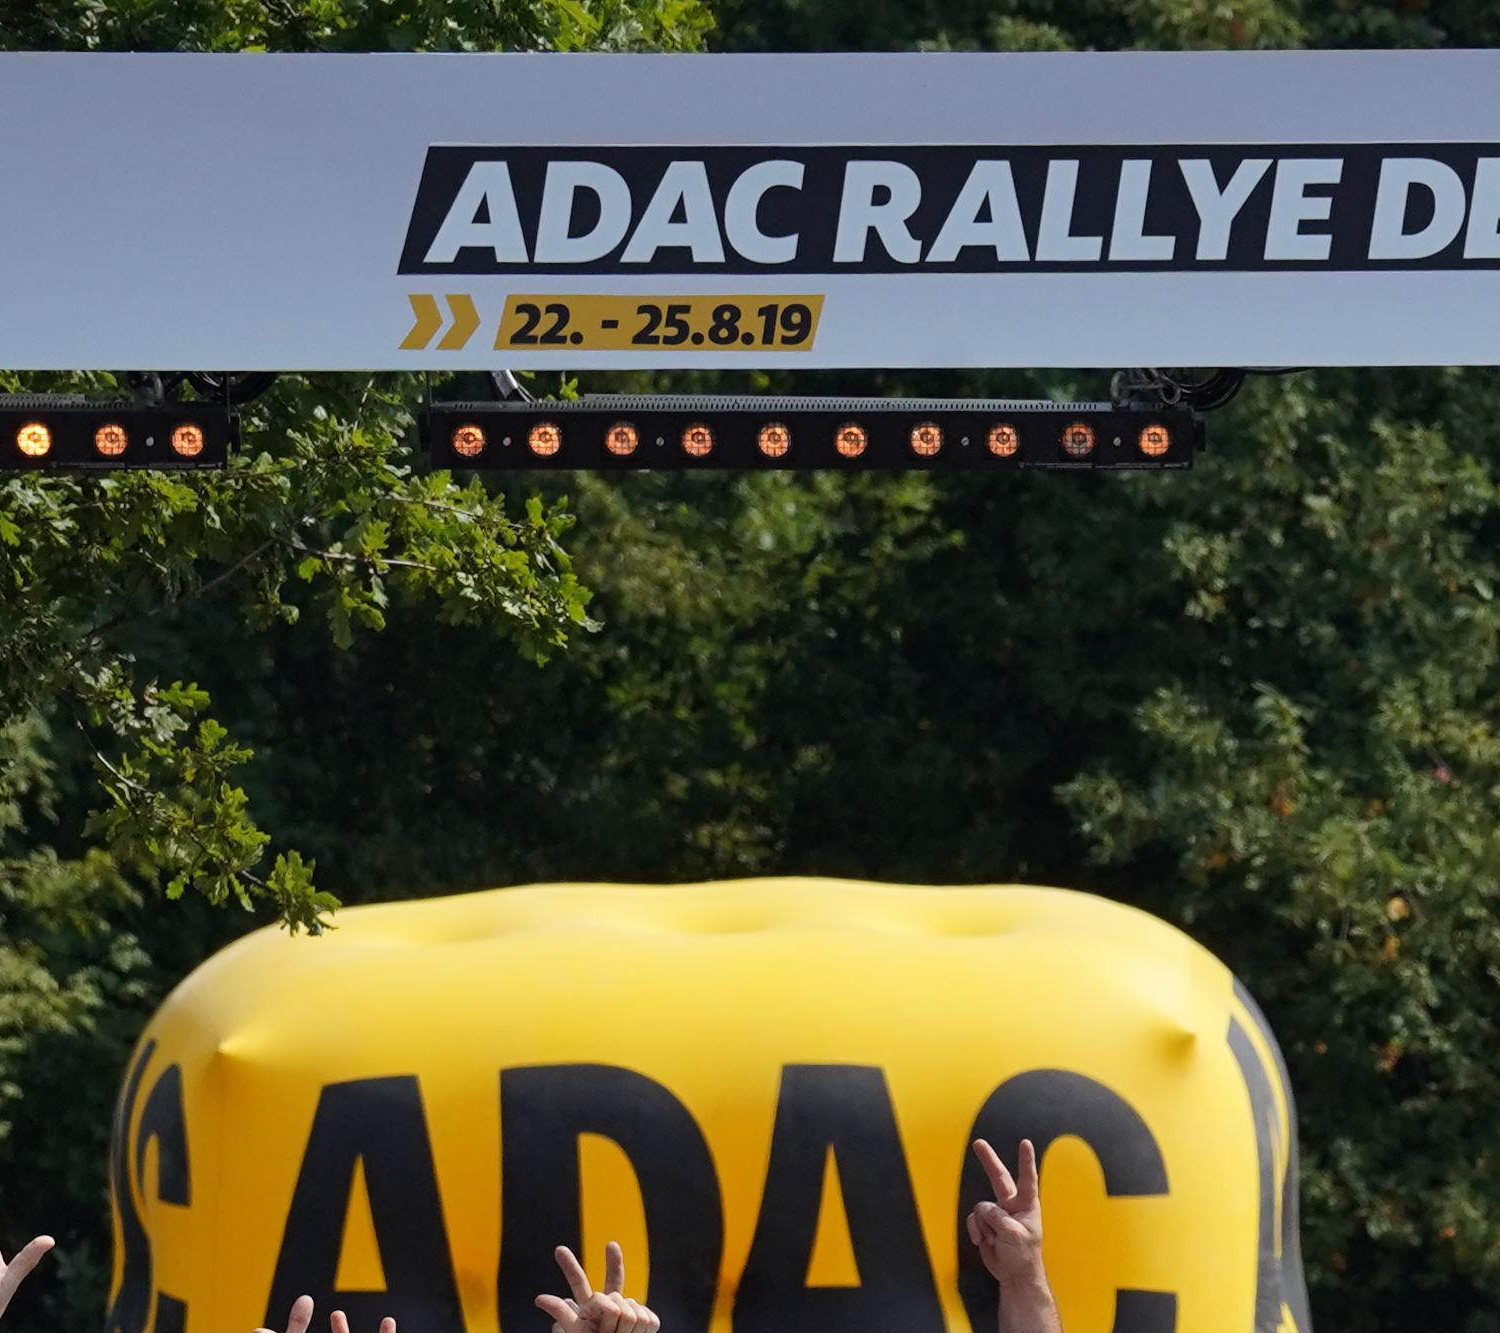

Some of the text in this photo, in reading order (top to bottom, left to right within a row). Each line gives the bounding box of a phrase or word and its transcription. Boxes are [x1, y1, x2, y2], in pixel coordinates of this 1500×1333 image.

[423, 158, 804, 264] ADAC
[835, 158, 1346, 264] RALLYE
[509, 303, 583, 346] 22.
[631, 302, 813, 347] 25.8.19
